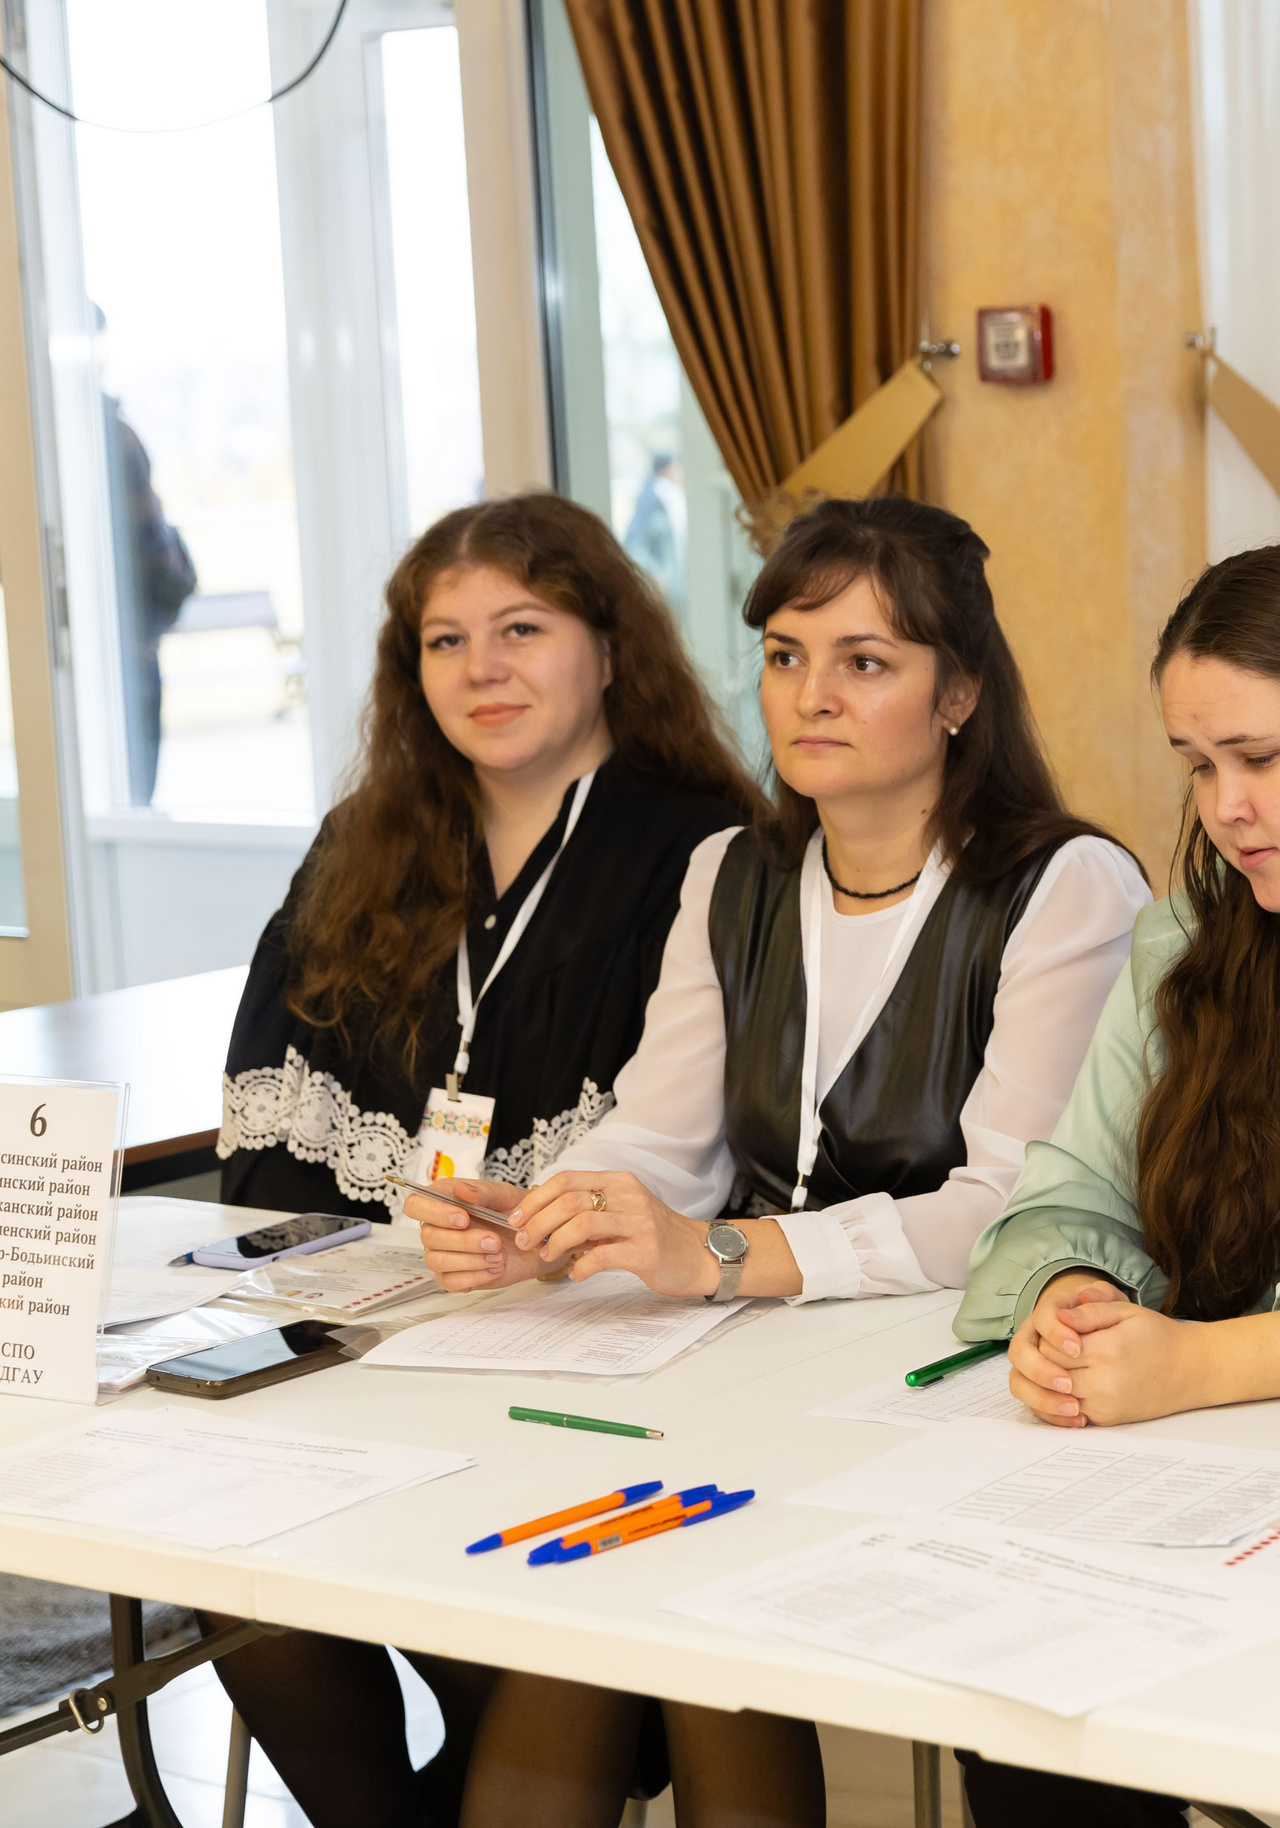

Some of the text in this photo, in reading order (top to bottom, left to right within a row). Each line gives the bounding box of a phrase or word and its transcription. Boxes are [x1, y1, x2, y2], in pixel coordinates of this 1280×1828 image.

[29, 1103, 48, 1137] 6
[61, 1155, 103, 1173] район
[48, 1178, 91, 1196] район
[56, 1203, 99, 1221] район
[55, 1228, 97, 1245] район
[2, 1270, 43, 1288] район
[28, 1297, 71, 1316] район
